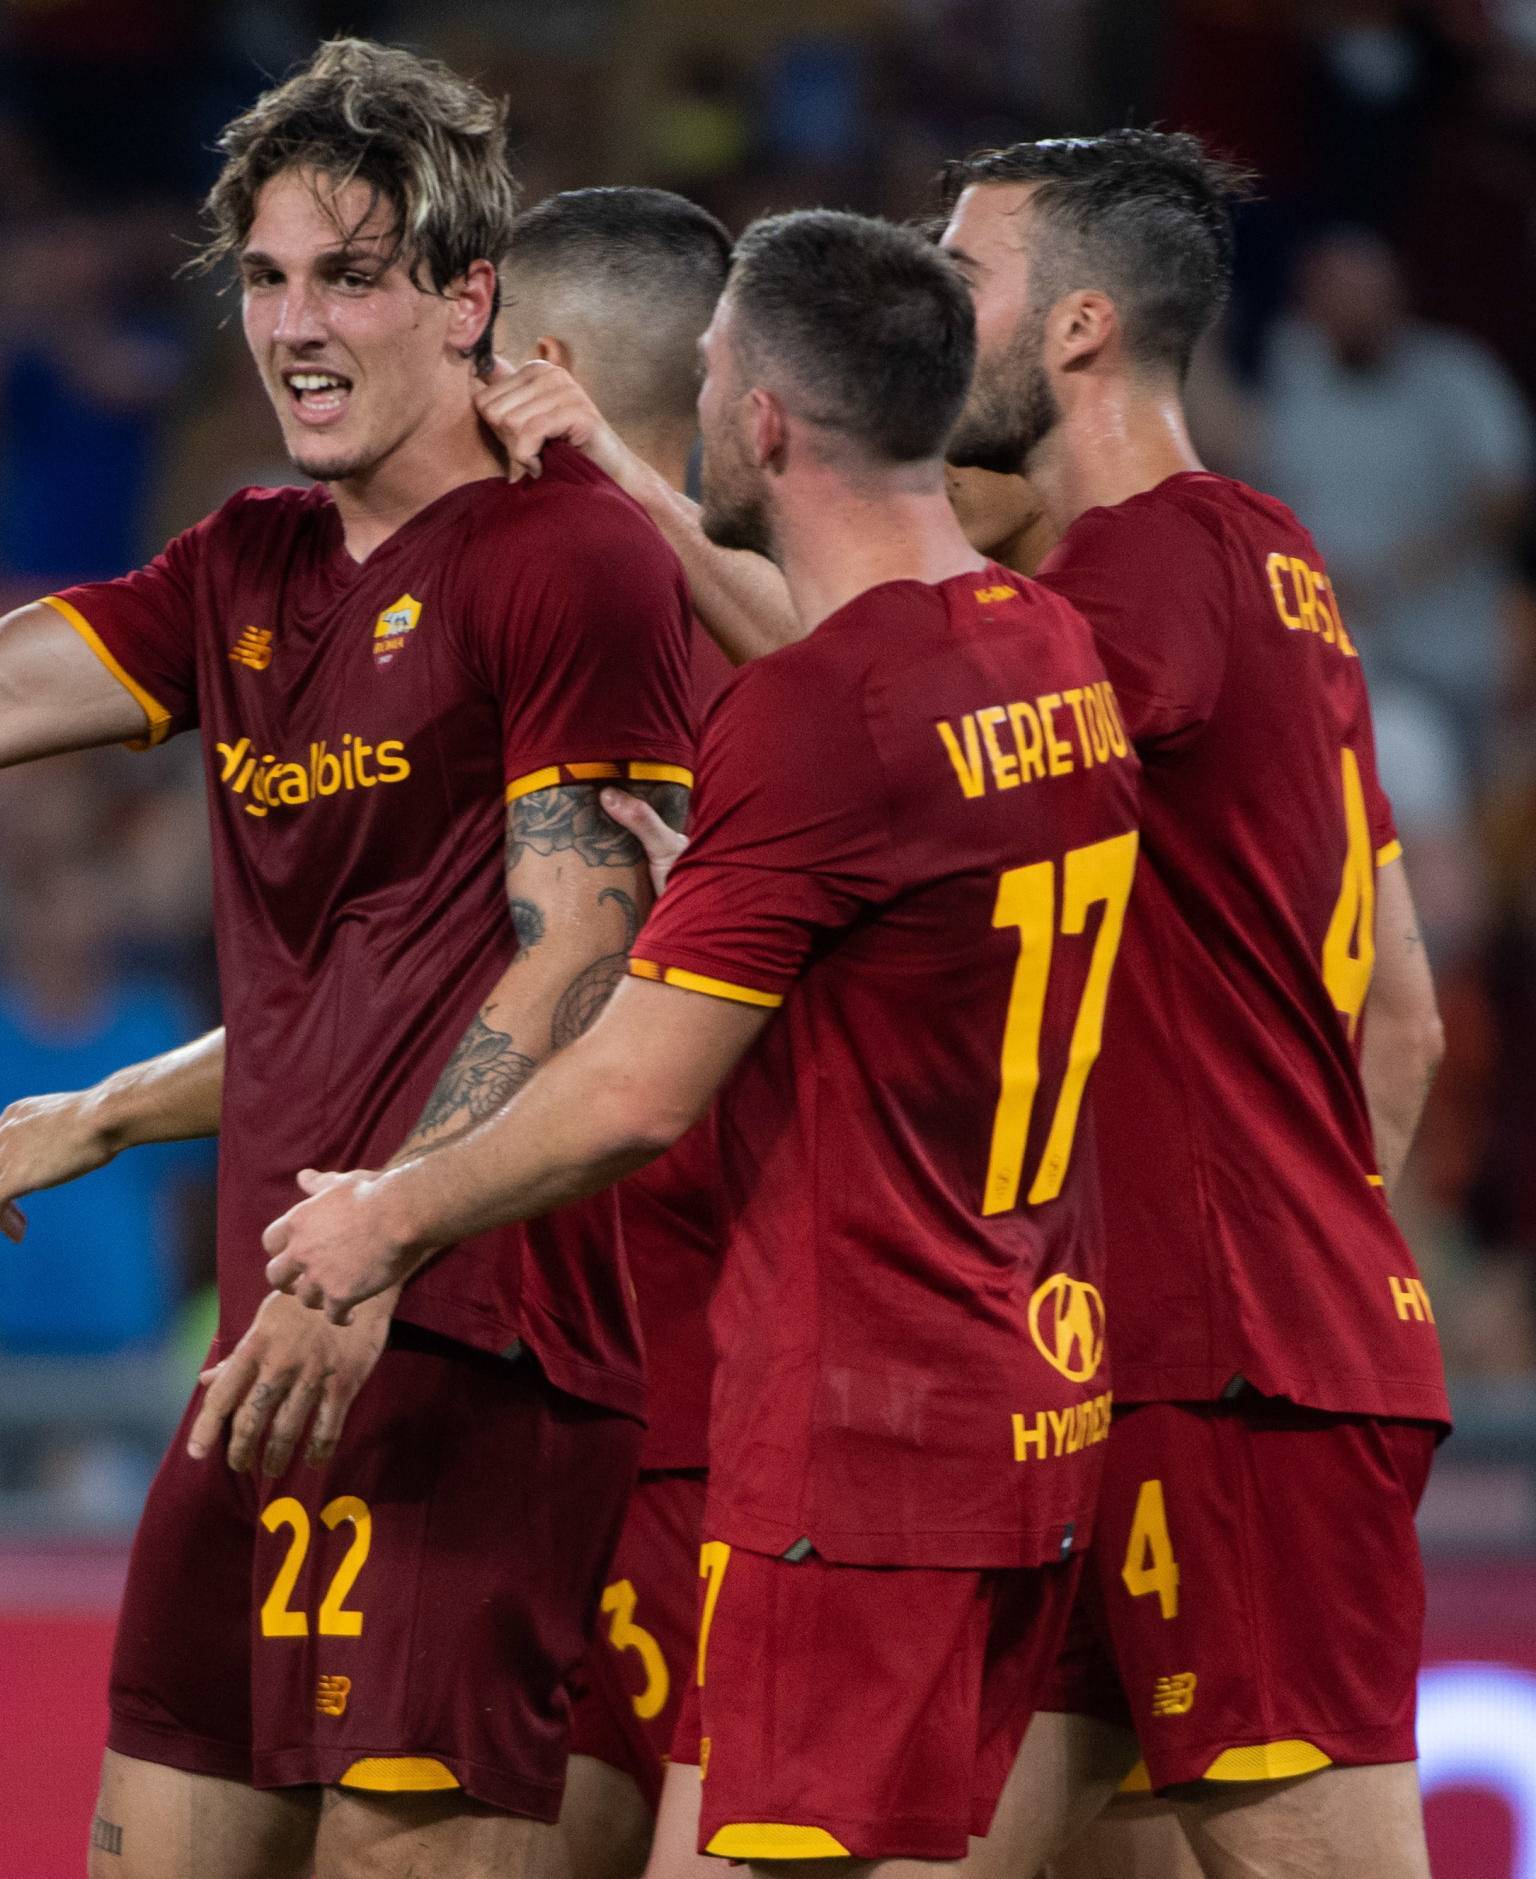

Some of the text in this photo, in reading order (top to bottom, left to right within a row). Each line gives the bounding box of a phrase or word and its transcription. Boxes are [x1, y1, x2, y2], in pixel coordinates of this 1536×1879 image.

[1322, 746, 1376, 1043] 4
[982, 830, 1139, 1216] 17
[260, 1495, 372, 1637] 22
[1121, 1479, 1179, 1620] 4
[601, 1579, 669, 1720] 3
